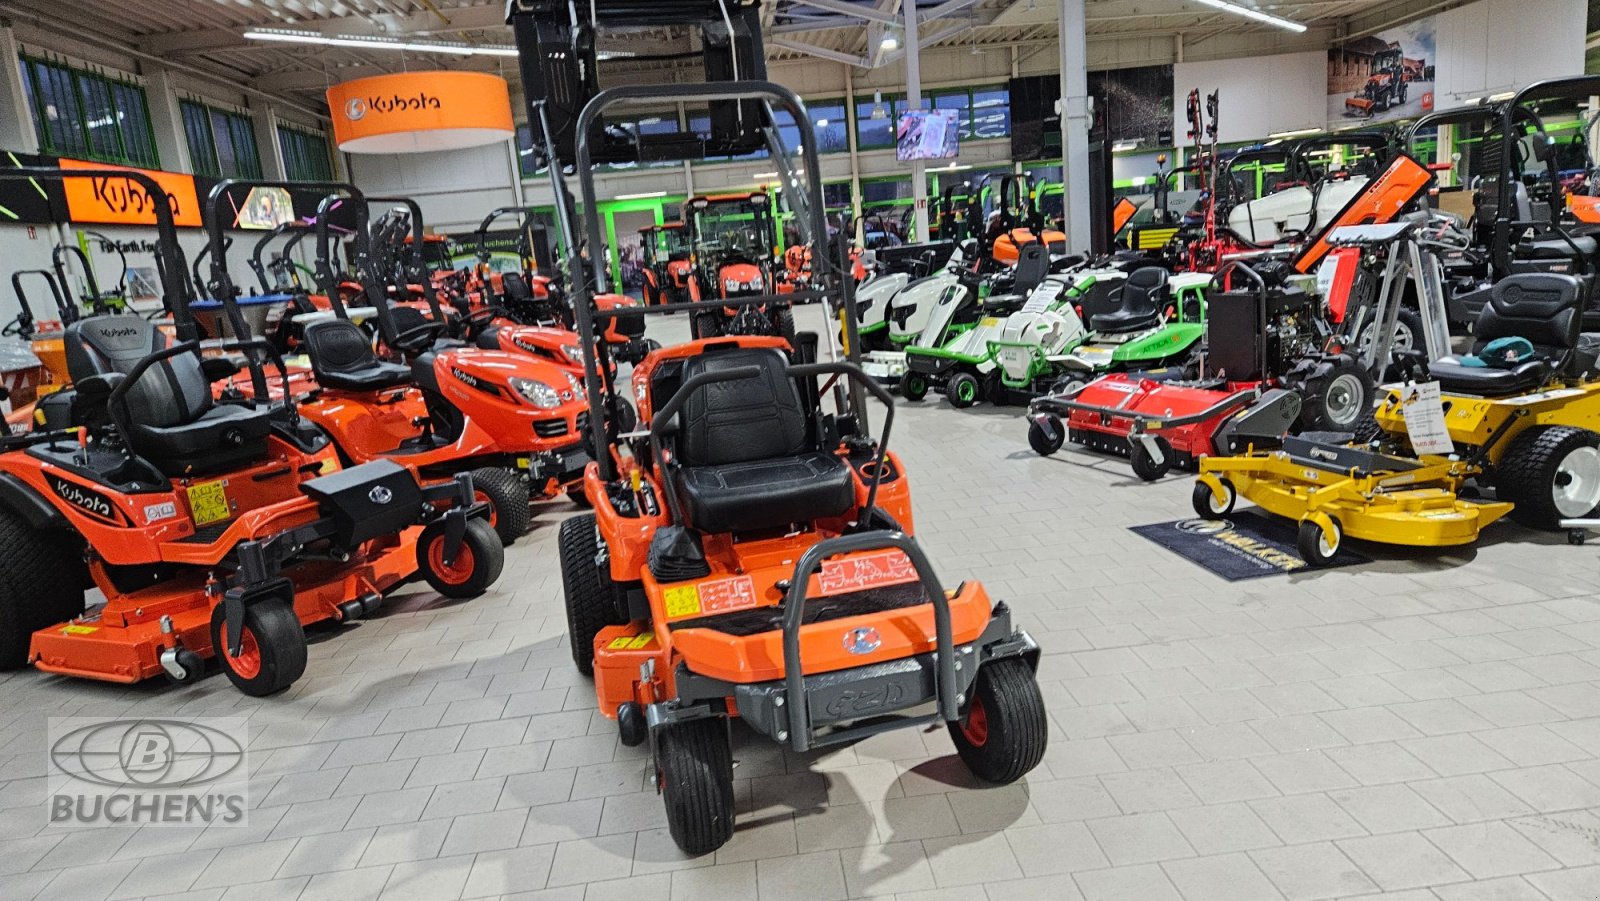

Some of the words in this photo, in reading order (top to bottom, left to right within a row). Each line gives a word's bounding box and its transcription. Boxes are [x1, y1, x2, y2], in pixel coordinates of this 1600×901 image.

[369, 92, 441, 113] Kubota
[91, 176, 180, 216] Kuboa
[100, 327, 137, 338] Kubota
[453, 367, 477, 387] Kubota
[56, 480, 110, 516] Kubota
